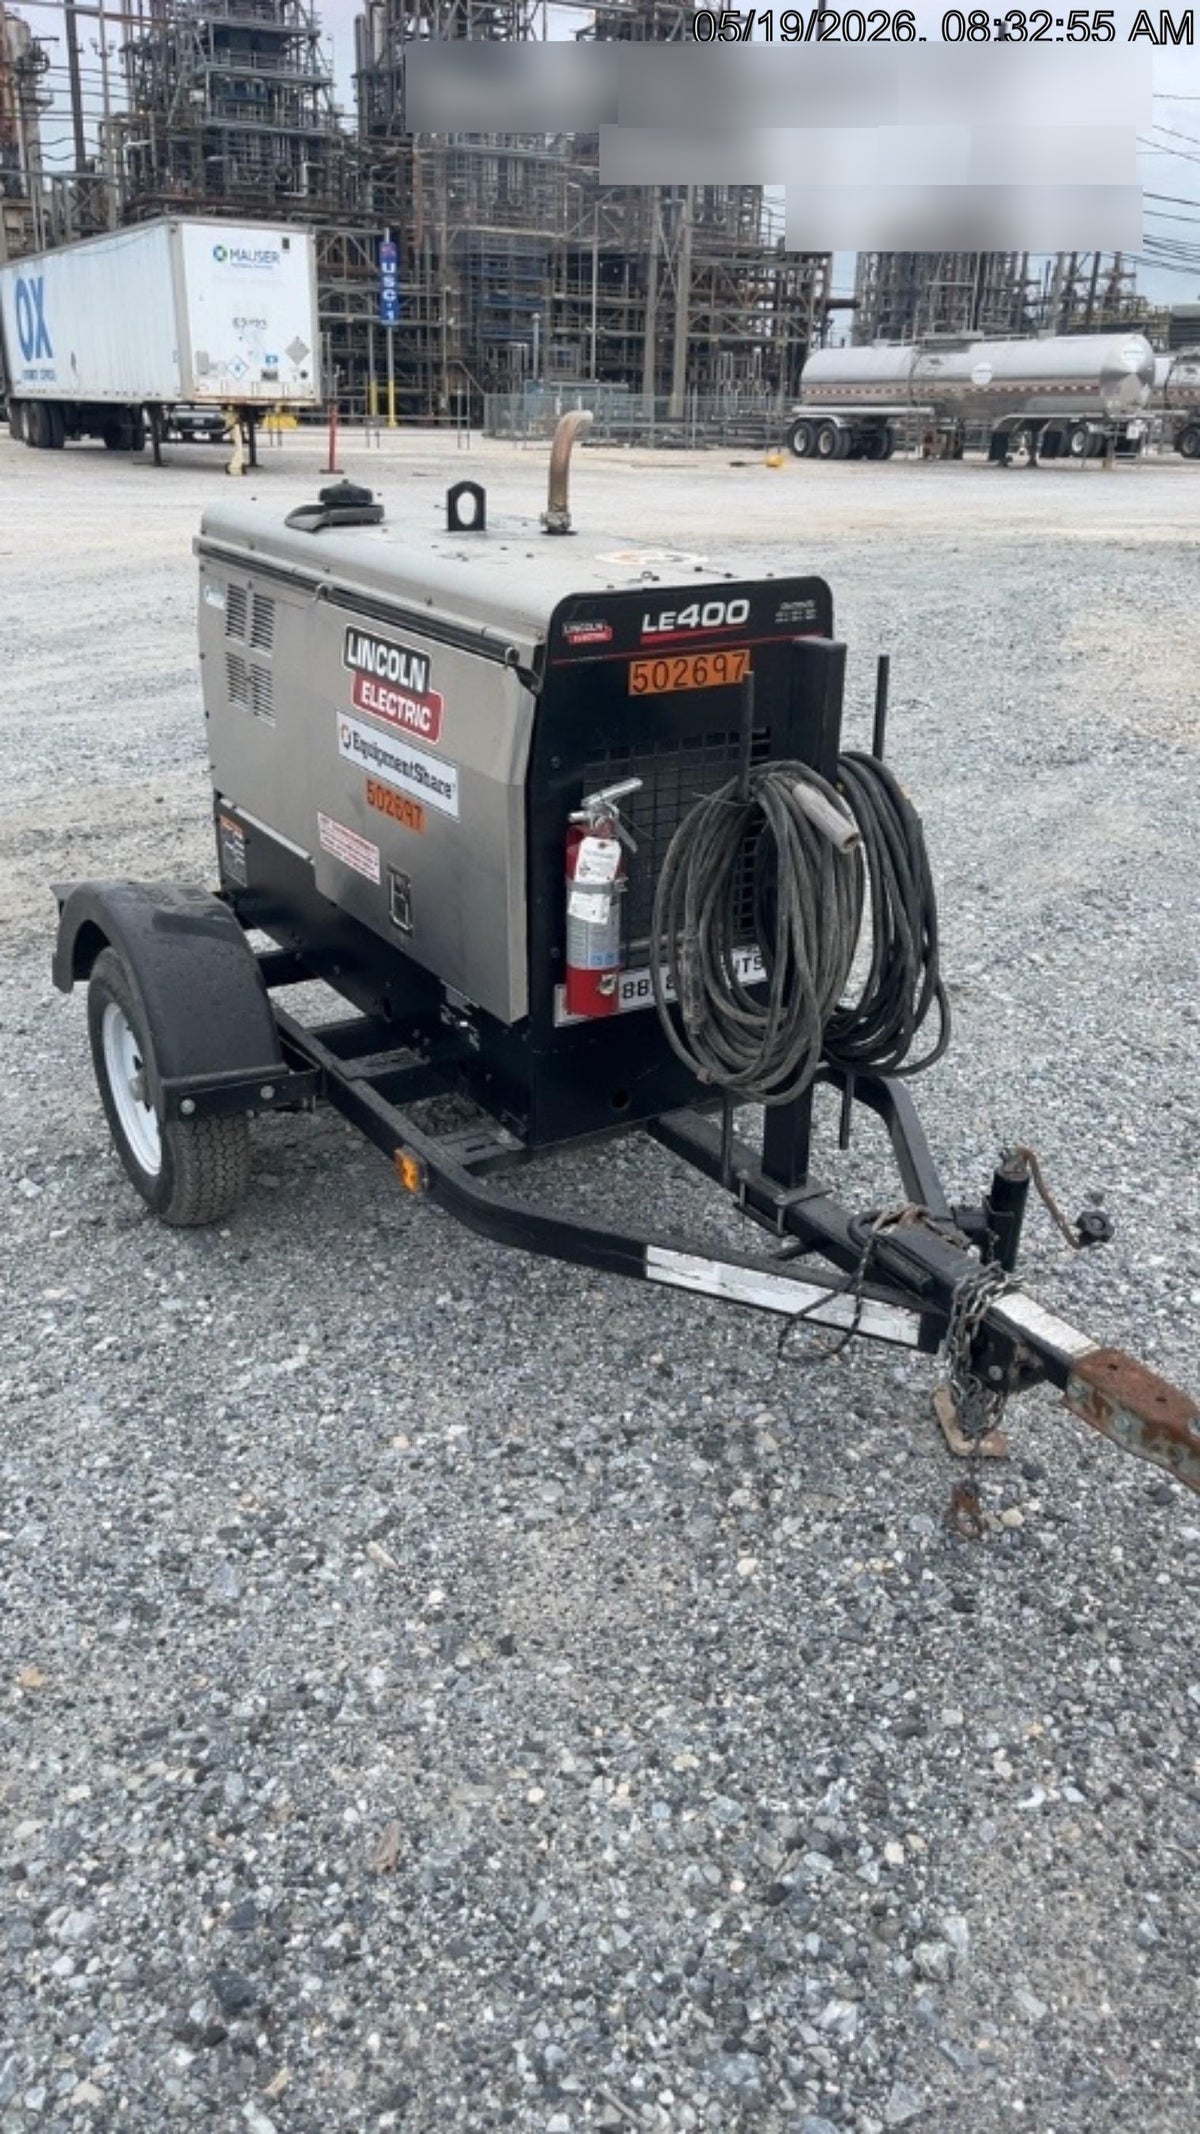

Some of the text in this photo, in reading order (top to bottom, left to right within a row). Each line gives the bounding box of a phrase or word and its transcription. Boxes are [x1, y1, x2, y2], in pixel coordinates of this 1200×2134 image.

[230, 248, 280, 263] MAUSER
[641, 599, 750, 633] LE400
[346, 632, 426, 693] LINCOLN
[632, 653, 746, 693] 502697
[361, 680, 432, 731] ELECTRIC
[367, 780, 423, 829] 502697
